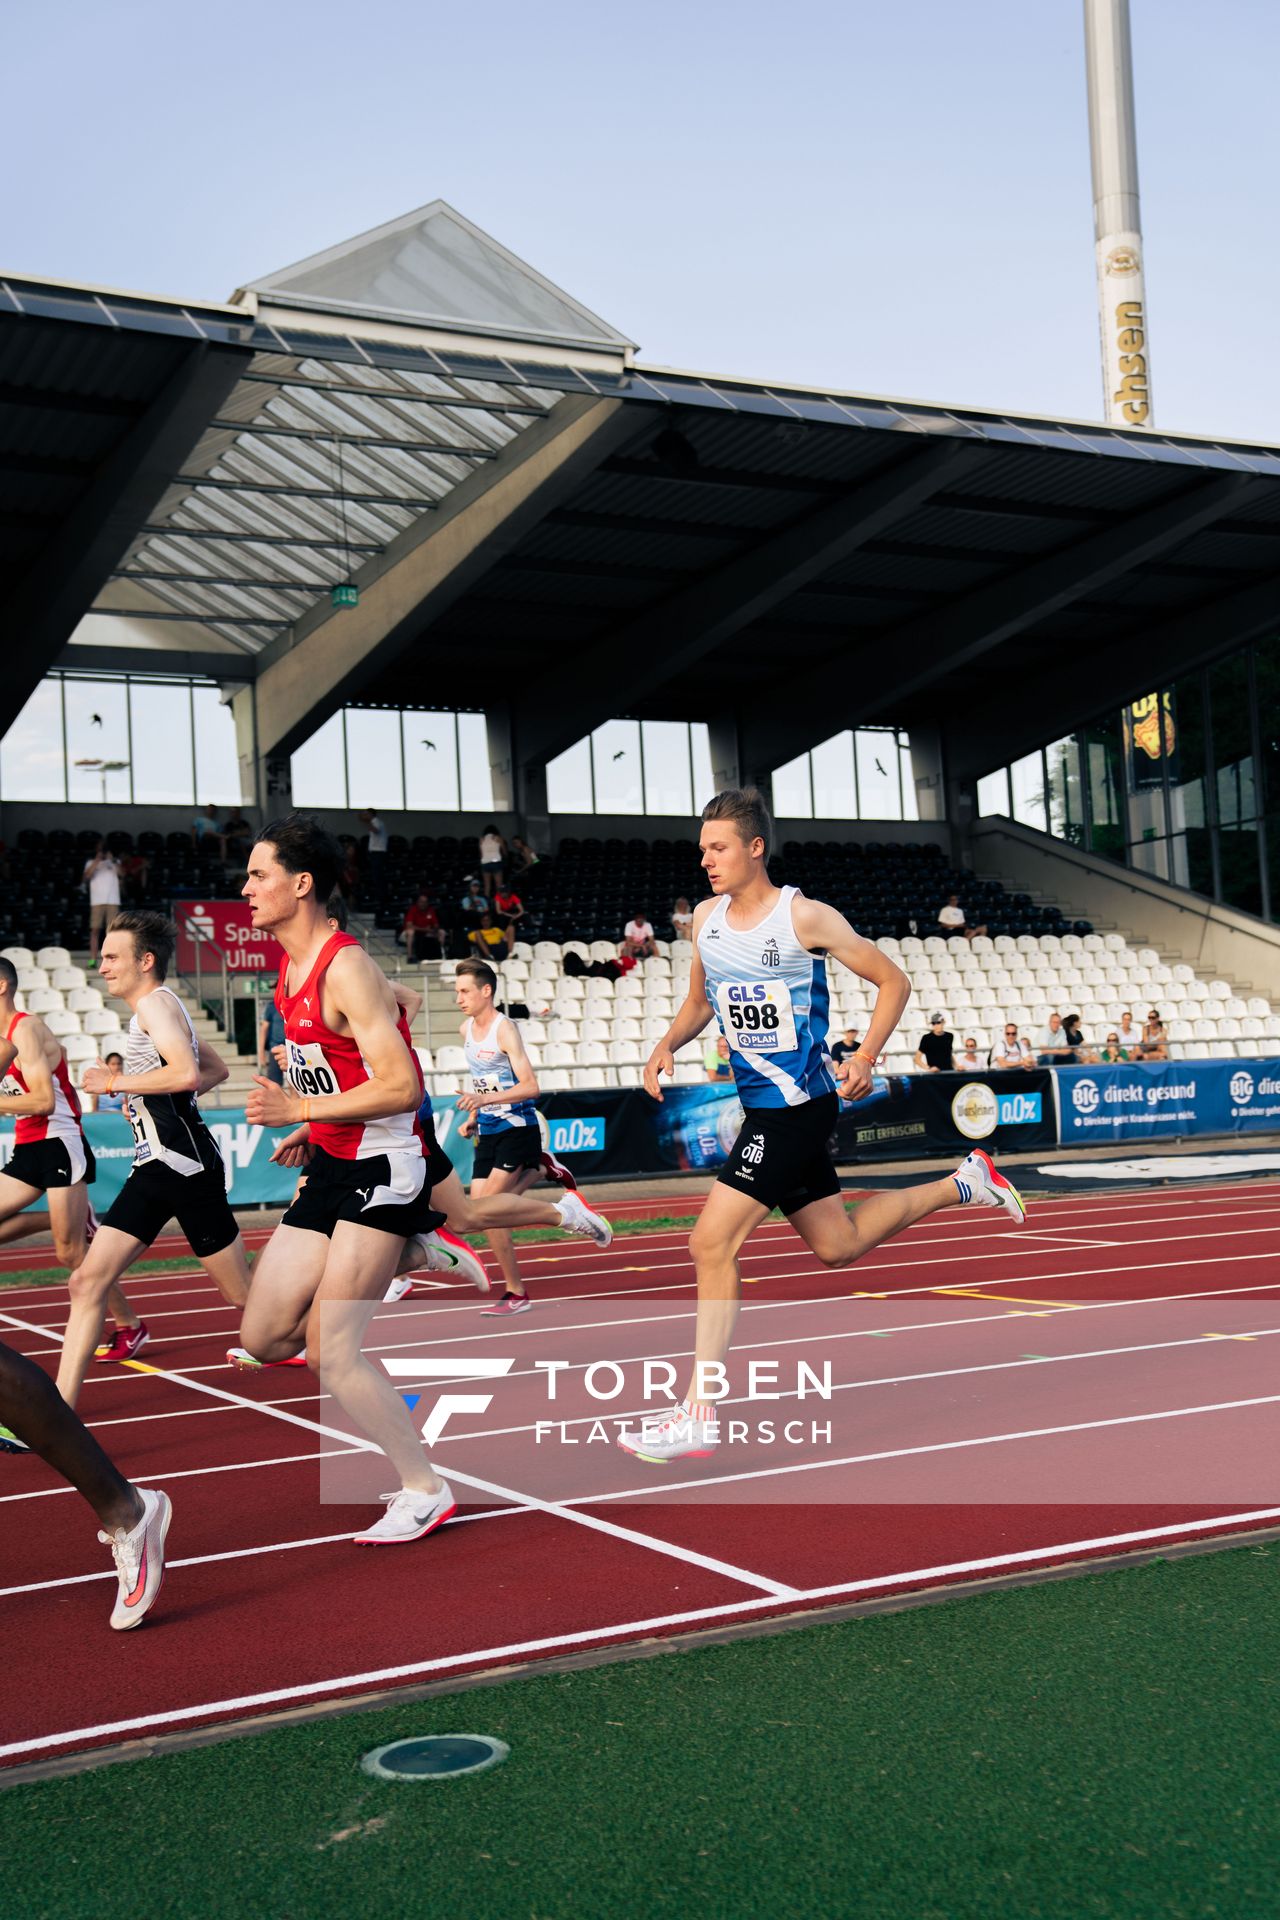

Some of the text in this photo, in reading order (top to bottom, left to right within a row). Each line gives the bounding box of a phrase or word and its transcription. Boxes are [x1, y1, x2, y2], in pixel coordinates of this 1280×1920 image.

[1114, 301, 1149, 427] chsen
[226, 949, 266, 968] Ulm
[728, 1004, 779, 1030] 598
[752, 1034, 776, 1044] PLAN
[289, 1065, 334, 1095] 1090
[1230, 1078, 1254, 1097] BIG
[1072, 1081, 1196, 1106] BIG direkt gesund
[1001, 1095, 1036, 1123] 0,0%
[554, 1119, 597, 1151] 0,0%
[856, 1122, 926, 1143] JETZT ERFRISCHEN
[741, 1143, 764, 1164] OTB
[735, 1170, 754, 1181] erima
